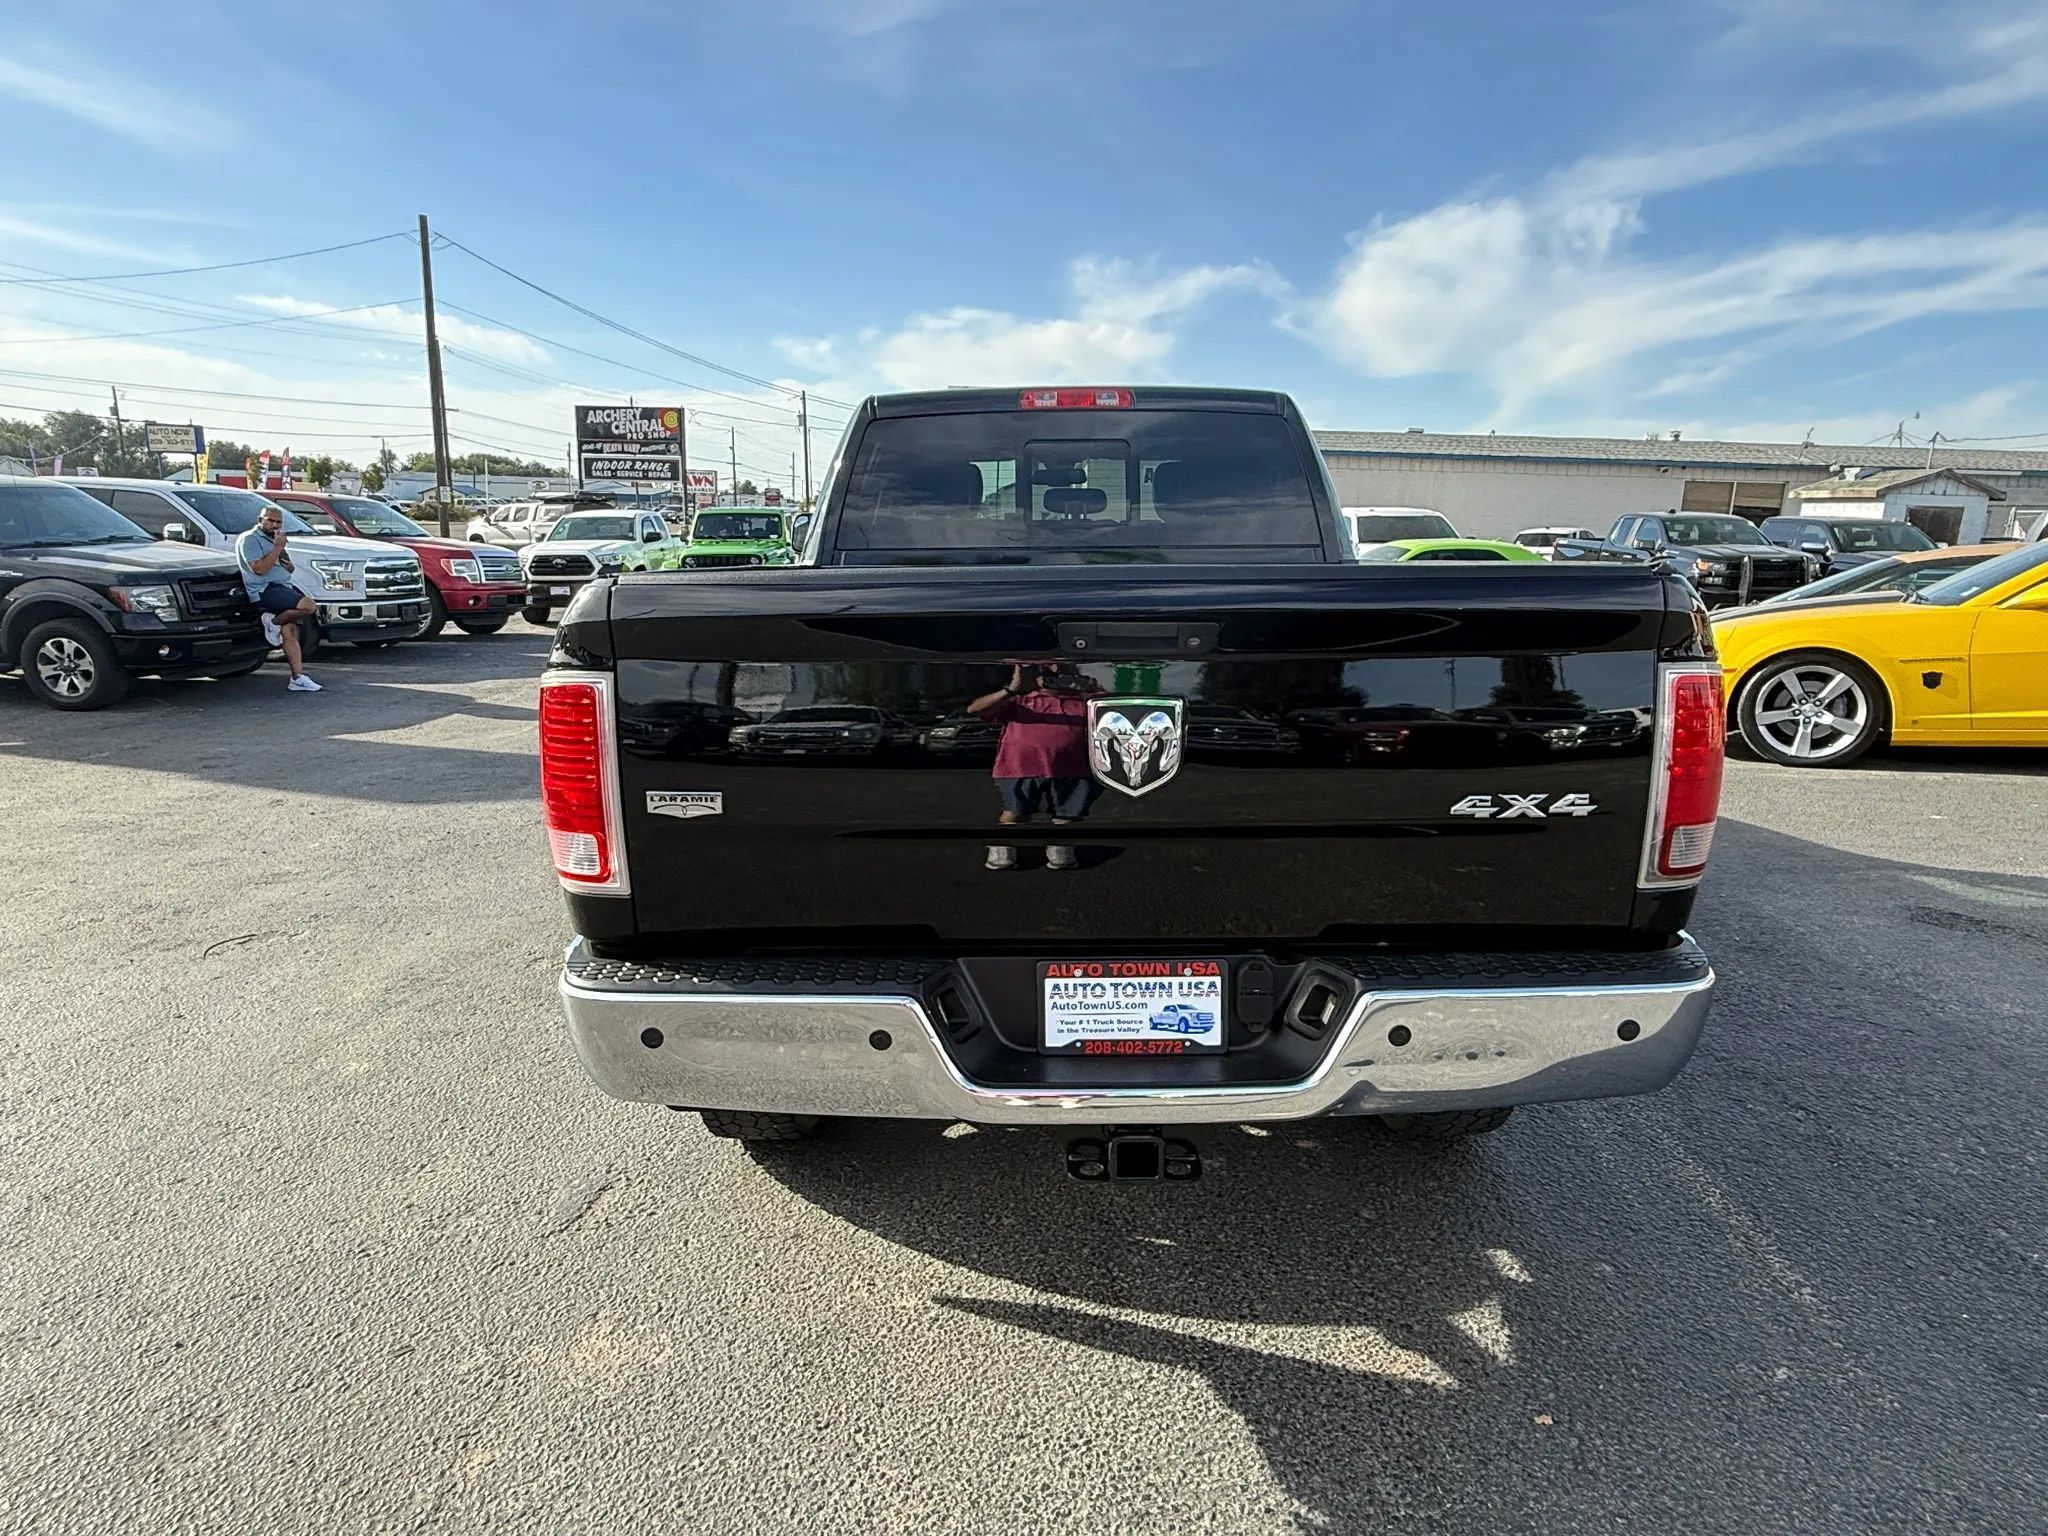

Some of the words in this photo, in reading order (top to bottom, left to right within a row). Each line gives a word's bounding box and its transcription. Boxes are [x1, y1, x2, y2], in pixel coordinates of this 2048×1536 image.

[586, 408, 642, 424] ARCHERY
[611, 419, 665, 435] CENTRAL
[648, 431, 671, 439] SHOP
[592, 460, 632, 470] INDOOR
[634, 461, 671, 472] RANGE
[649, 795, 718, 803] LARAMIE
[1450, 793, 1598, 818] 4X4
[1046, 963, 1103, 977] AUTO
[1109, 963, 1170, 976] TOWN
[1177, 962, 1220, 976] USA
[1049, 982, 1106, 999] AUTO
[1110, 982, 1173, 998] TOWN
[1178, 981, 1219, 998] USA
[1051, 1001, 1148, 1011] AutoTownUS.com
